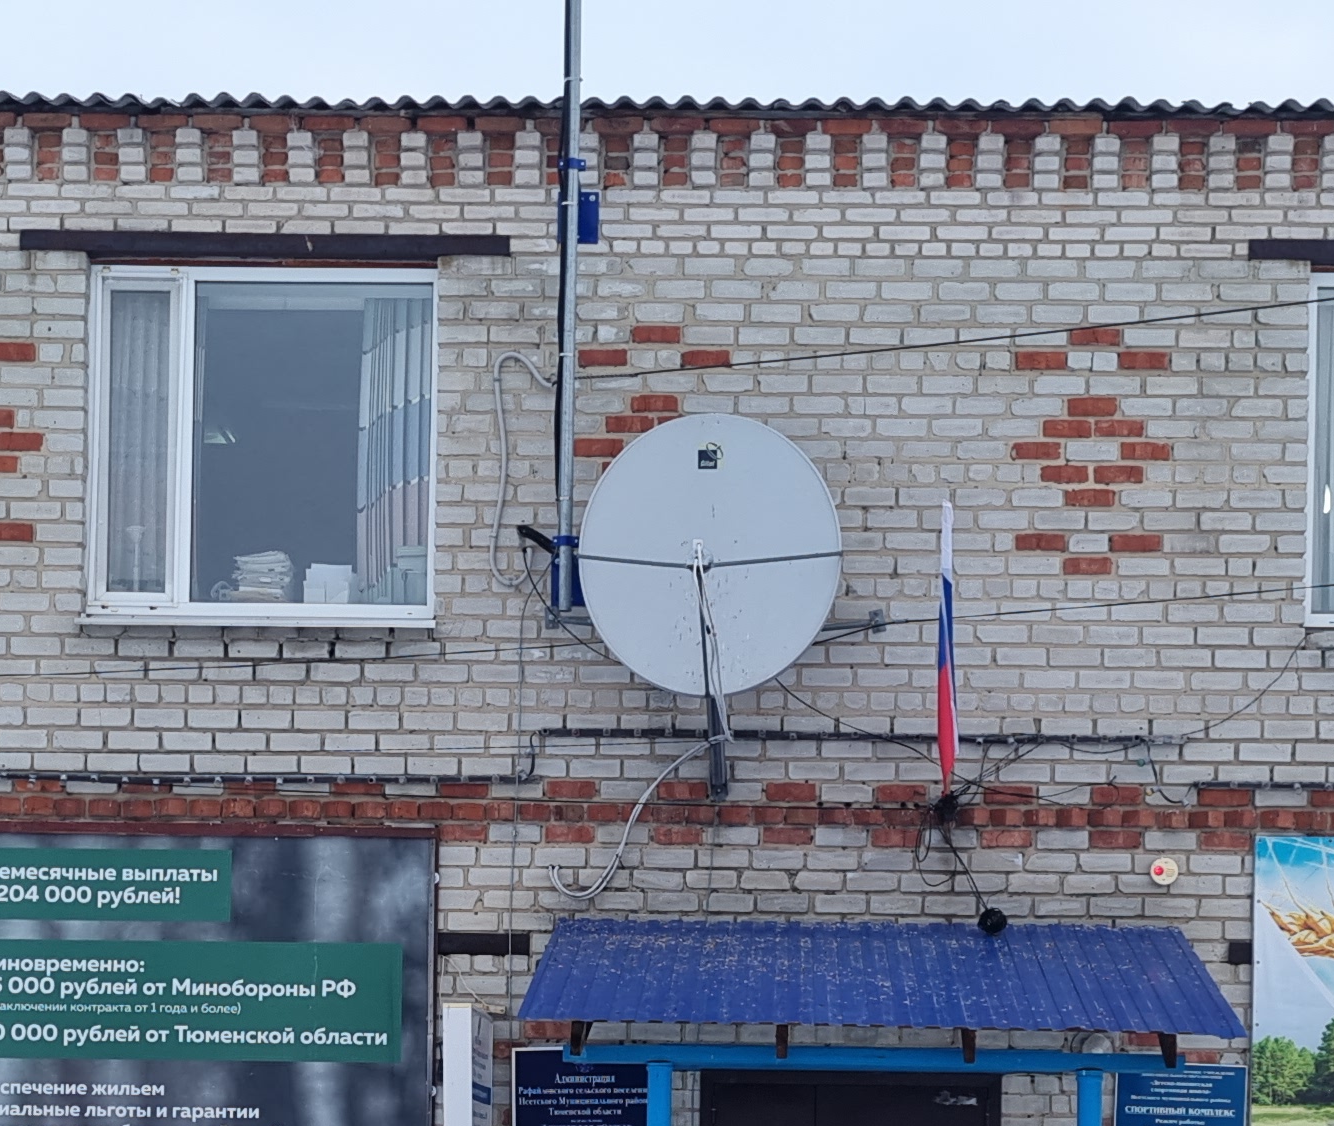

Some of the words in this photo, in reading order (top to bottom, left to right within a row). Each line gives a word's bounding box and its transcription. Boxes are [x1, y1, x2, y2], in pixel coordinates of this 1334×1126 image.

[122, 866, 218, 883] выплаты
[45, 886, 92, 904] 000
[97, 886, 181, 908] рублей!
[7, 977, 56, 995] 000
[60, 977, 138, 1000] рублей
[142, 982, 166, 996] от
[171, 978, 317, 1001] Минобороны
[321, 979, 356, 999] РФ
[70, 1003, 132, 1015] контракта
[135, 1004, 149, 1013] от
[151, 1003, 157, 1013] 1
[159, 1004, 188, 1015] года
[190, 1005, 199, 1014] и
[201, 1001, 242, 1016] более)
[10, 1024, 58, 1042] 000
[63, 1024, 141, 1047] рублей
[145, 1028, 170, 1043] от
[174, 1025, 295, 1045] Тюменской
[300, 1027, 388, 1046] области
[91, 1082, 165, 1097] жильем
[84, 1105, 152, 1120] льготы
[156, 1106, 167, 1119] и
[172, 1105, 260, 1123] гарантии
